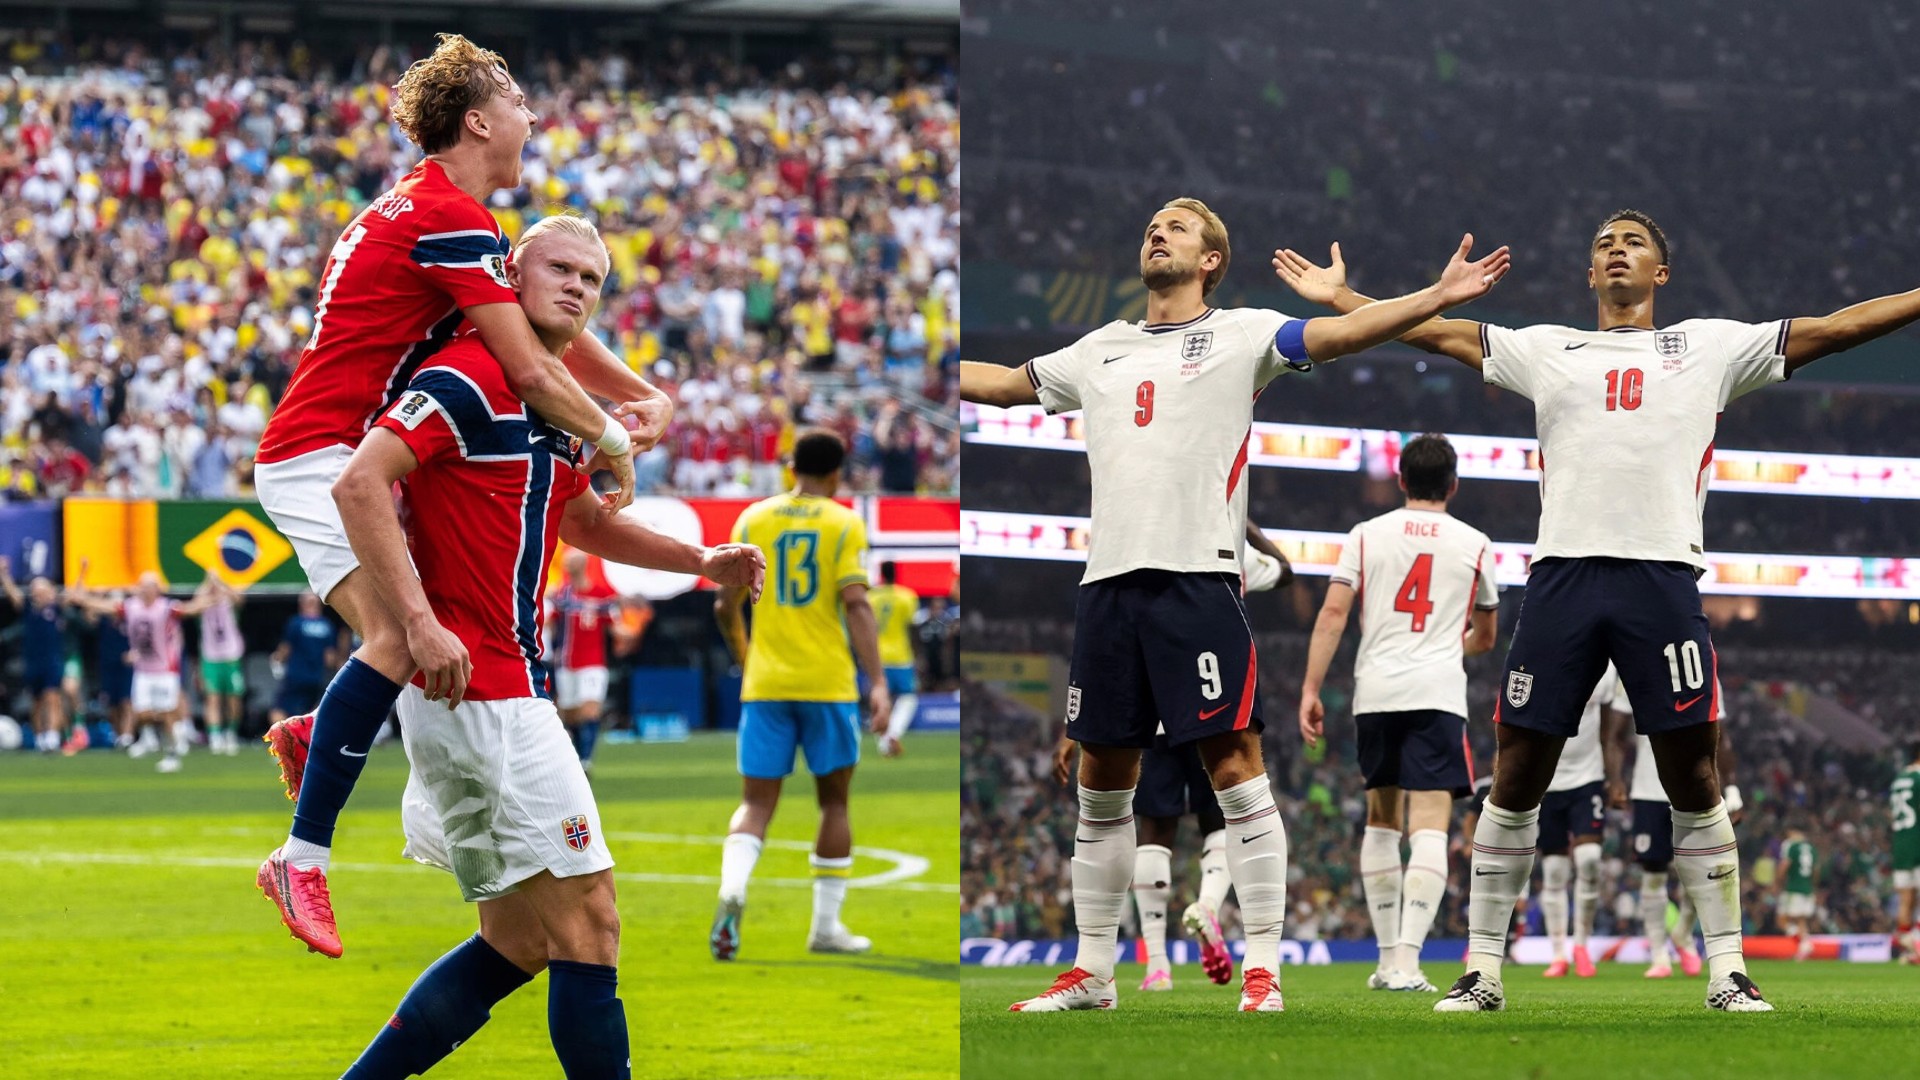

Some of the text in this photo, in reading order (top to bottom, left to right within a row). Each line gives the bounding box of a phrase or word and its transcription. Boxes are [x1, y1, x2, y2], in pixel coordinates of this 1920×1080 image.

[1134, 380, 1155, 428] 9
[1605, 367, 1644, 411] 10
[1404, 521, 1440, 538] RICE
[773, 529, 821, 607] 13
[1393, 553, 1434, 633] 4
[1196, 651, 1223, 701] 9
[1663, 639, 1704, 693] 10
[1591, 794, 1605, 820] 2
